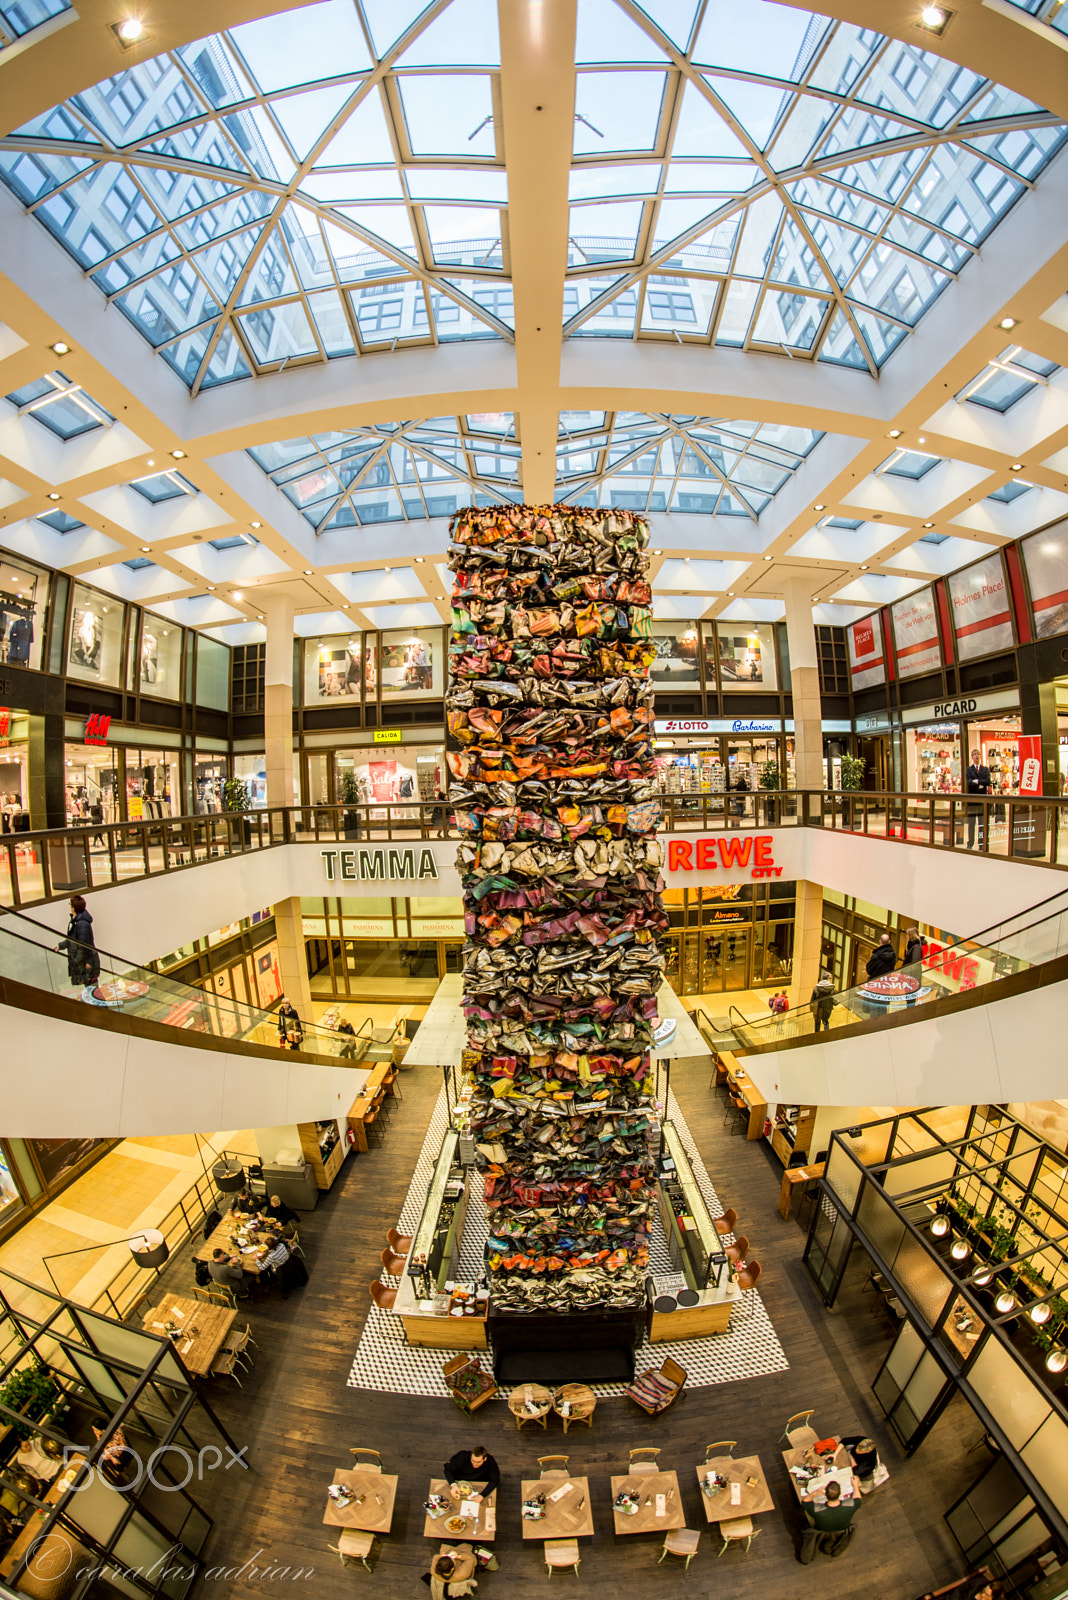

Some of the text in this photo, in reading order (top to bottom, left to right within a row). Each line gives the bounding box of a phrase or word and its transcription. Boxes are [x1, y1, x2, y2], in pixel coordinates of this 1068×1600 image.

[954, 579, 1005, 608] Holmes Place!
[912, 615, 924, 625] Welt
[925, 612, 934, 620] von
[855, 630, 872, 641] HOLMES
[858, 636, 871, 645] PLACE
[934, 699, 977, 717] PICARD
[86, 713, 111, 738] H&M
[679, 721, 709, 730] LOTTO
[925, 733, 950, 741] PICARD
[1025, 764, 1036, 788] SALE
[668, 836, 775, 871] REWE
[320, 848, 439, 880] TEMMA
[751, 867, 783, 878] CITY
[715, 911, 740, 919] Almano
